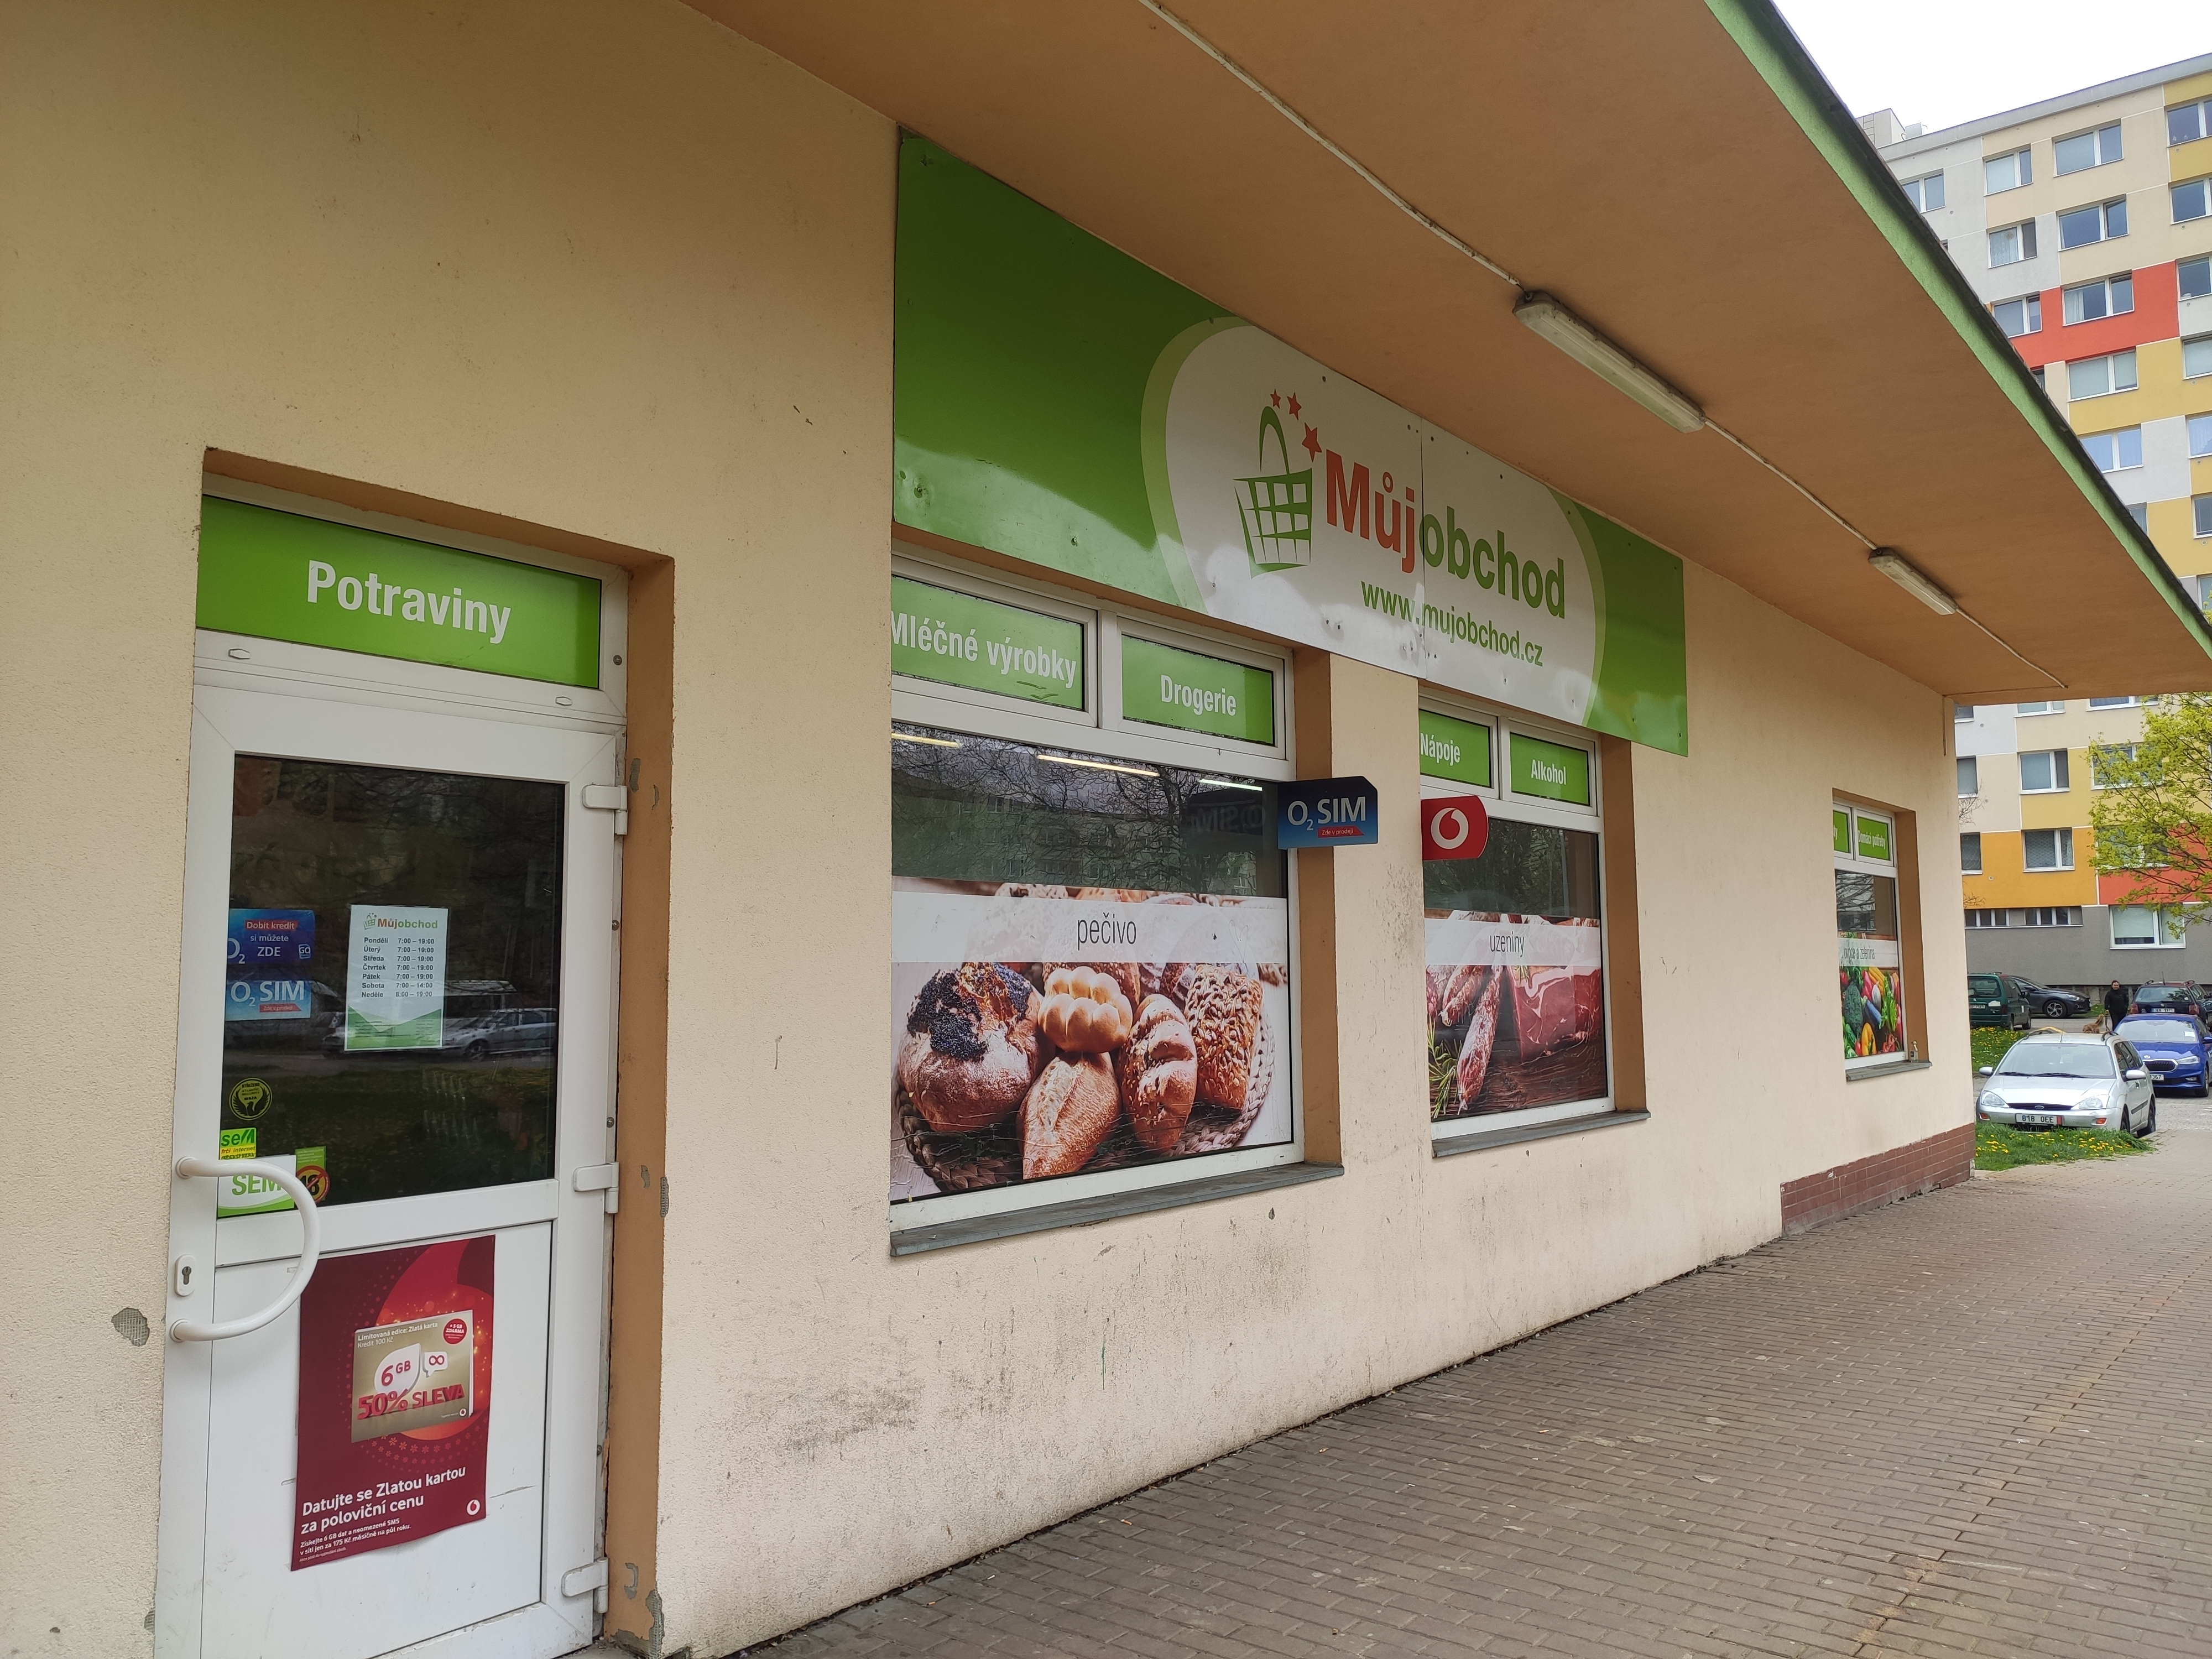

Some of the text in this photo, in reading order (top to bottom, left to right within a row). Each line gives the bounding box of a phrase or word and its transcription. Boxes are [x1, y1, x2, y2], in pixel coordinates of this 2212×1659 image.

[1326, 448, 1564, 619] Můjobchod
[307, 560, 511, 644] Potraviny
[1361, 581, 1543, 667] www.mujobchod.cz
[891, 611, 1076, 688] Mléčné výrobky
[1161, 674, 1237, 717] Drogerie
[1421, 733, 1460, 766] Nápoje
[1531, 759, 1567, 785] Alkohol
[1317, 796, 1366, 824] SIM
[271, 921, 295, 930] kredit
[377, 918, 438, 930] Můjobchod
[1077, 912, 1136, 951] pečivo
[259, 933, 289, 942] můžete
[364, 945, 380, 953] Úterý
[1490, 931, 1525, 957] uzeniny
[257, 947, 281, 957] ZDE
[259, 980, 304, 1001] SIM
[358, 1331, 390, 1341] Limitovaná
[358, 1340, 374, 1348] Kredit
[381, 1360, 411, 1386] 6 GB
[357, 1384, 465, 1420] 50% SLEVA
[302, 1467, 466, 1516] Datujte se Zlatou kartou
[301, 1495, 424, 1535] za poloviční cenu
[300, 1537, 322, 1548] Získejte
[353, 1522, 386, 1534] neomezené
[333, 1538, 342, 1547] 175
[386, 1525, 395, 1535] půl
